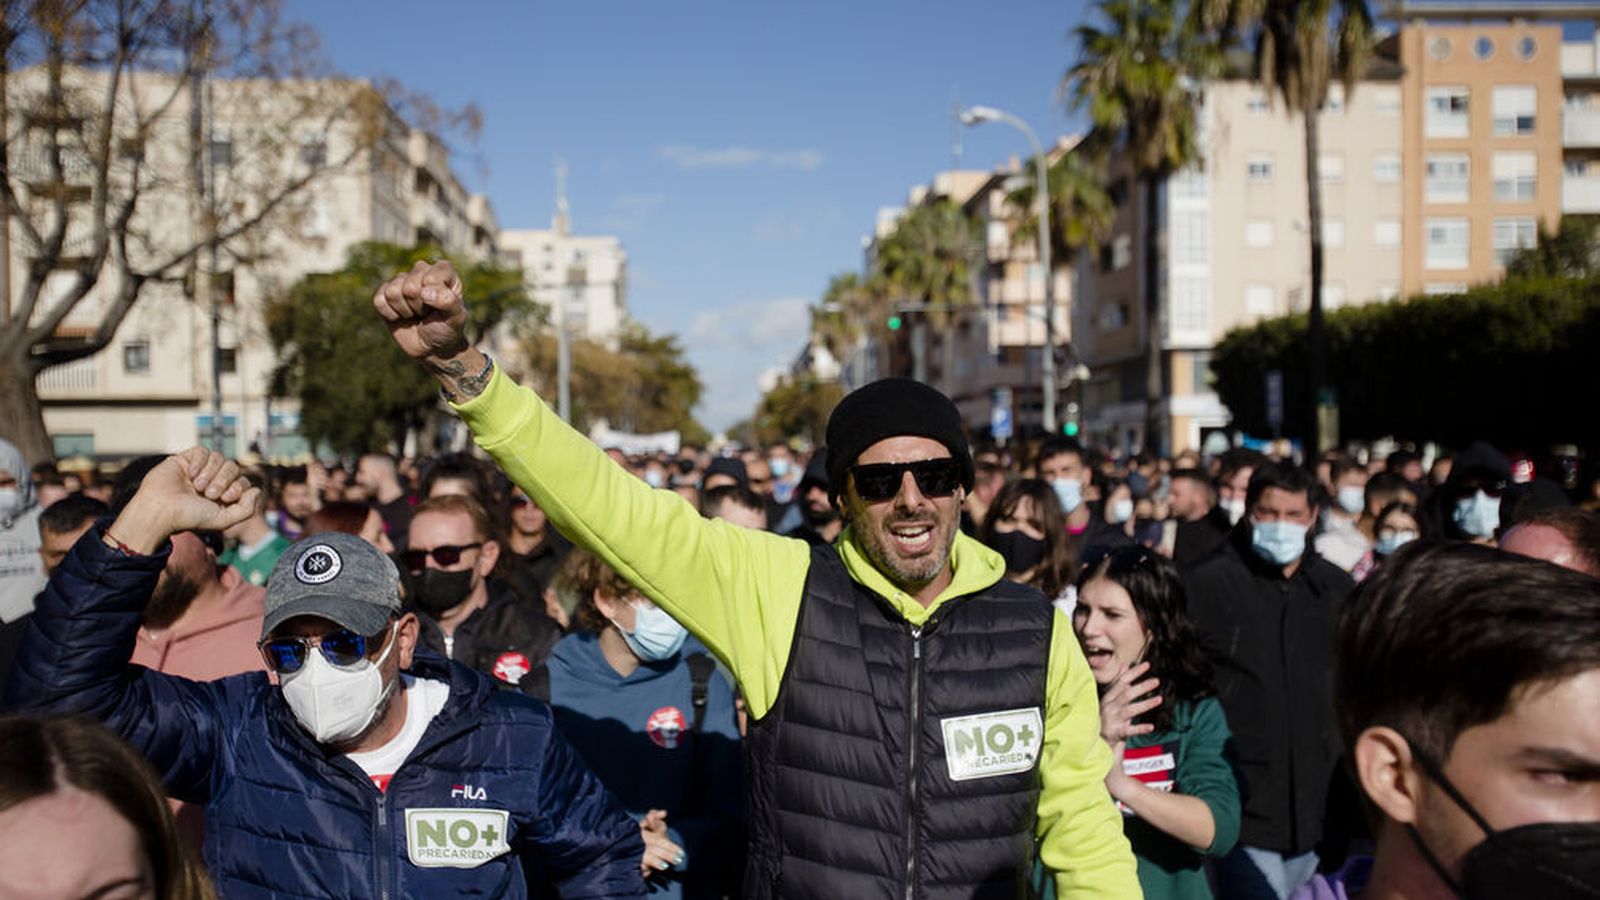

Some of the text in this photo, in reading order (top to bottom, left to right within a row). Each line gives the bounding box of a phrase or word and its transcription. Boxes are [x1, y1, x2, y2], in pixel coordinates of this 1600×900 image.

[953, 724, 1035, 756] NO+
[451, 784, 487, 800] FILA
[416, 819, 499, 848] NO+
